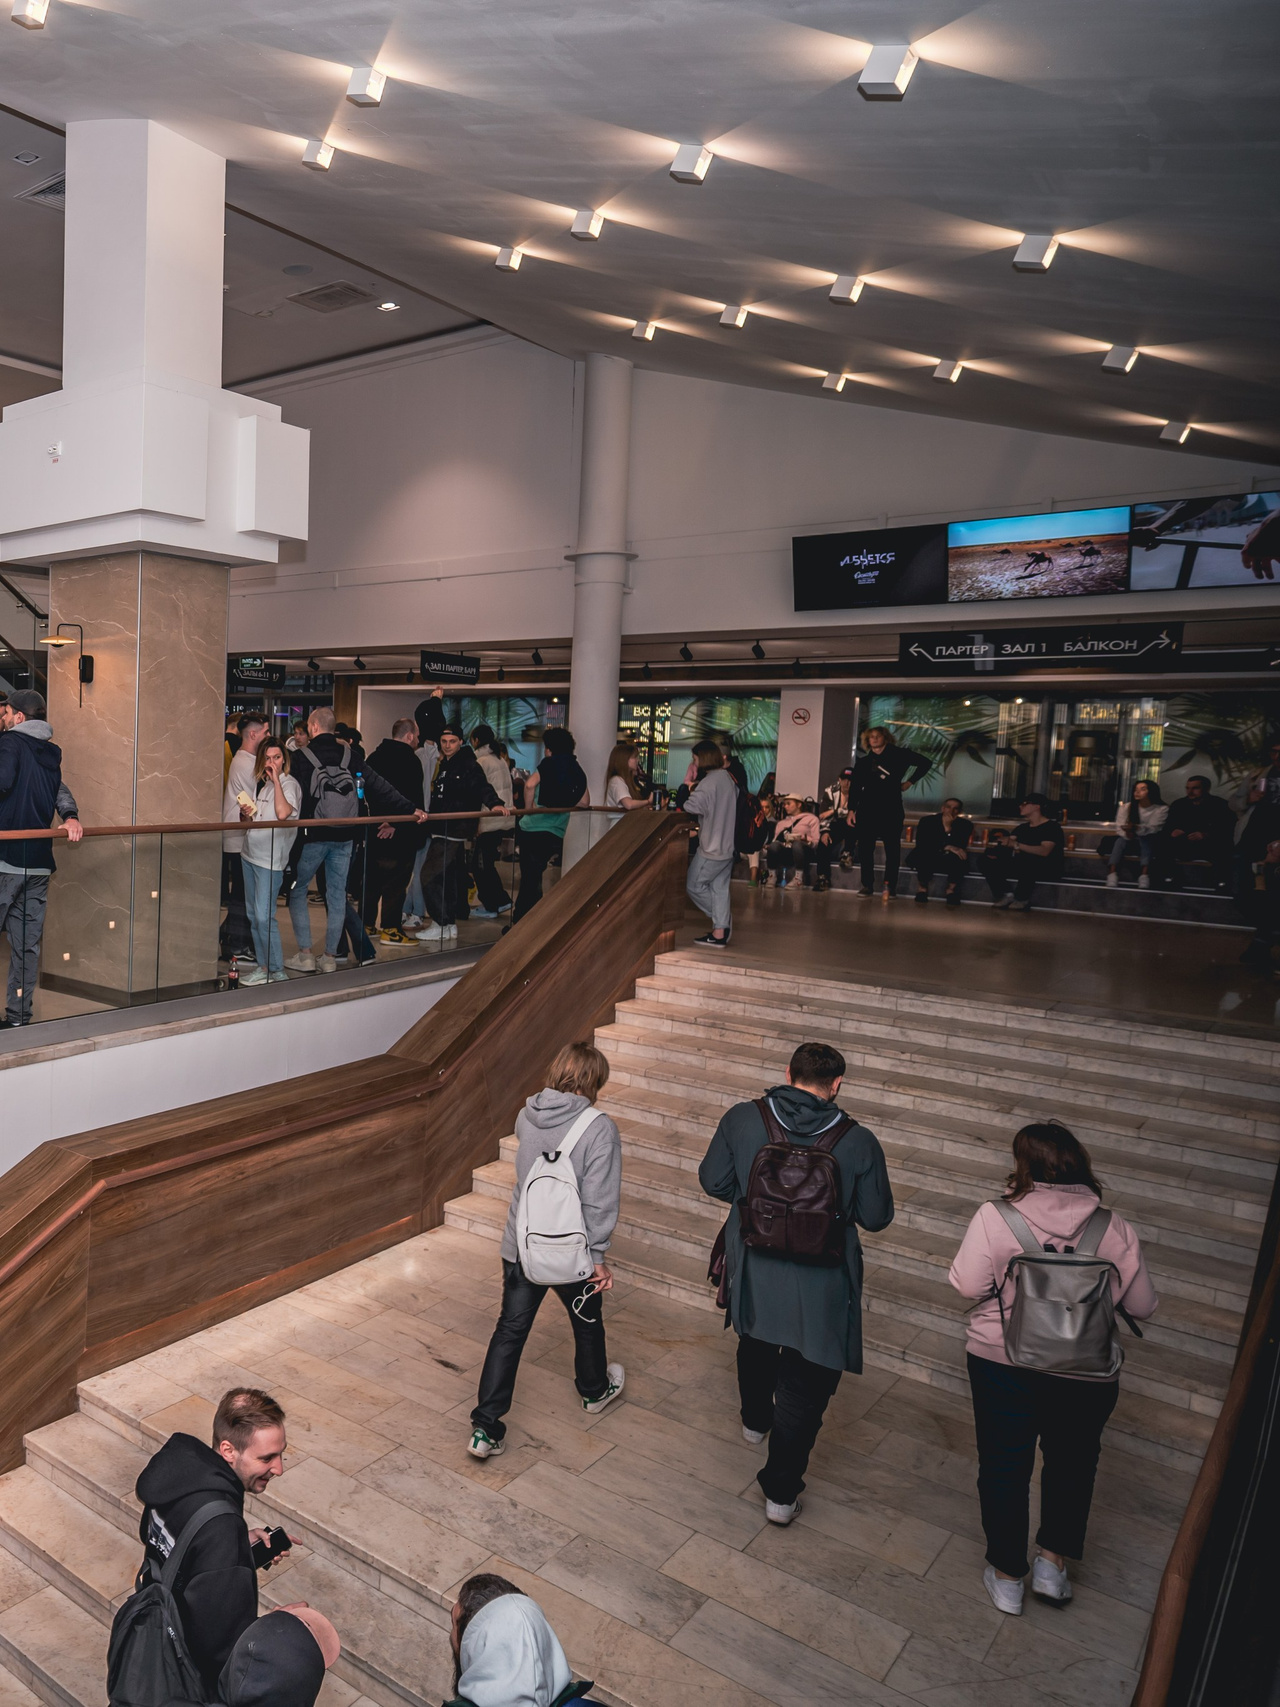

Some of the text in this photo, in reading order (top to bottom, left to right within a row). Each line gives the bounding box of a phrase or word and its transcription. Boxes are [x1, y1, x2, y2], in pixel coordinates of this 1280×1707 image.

[935, 640, 1138, 656] ПАРТЕР ЗАЛ 1 БАЛКОН
[431, 662, 441, 671] ЗАЛ
